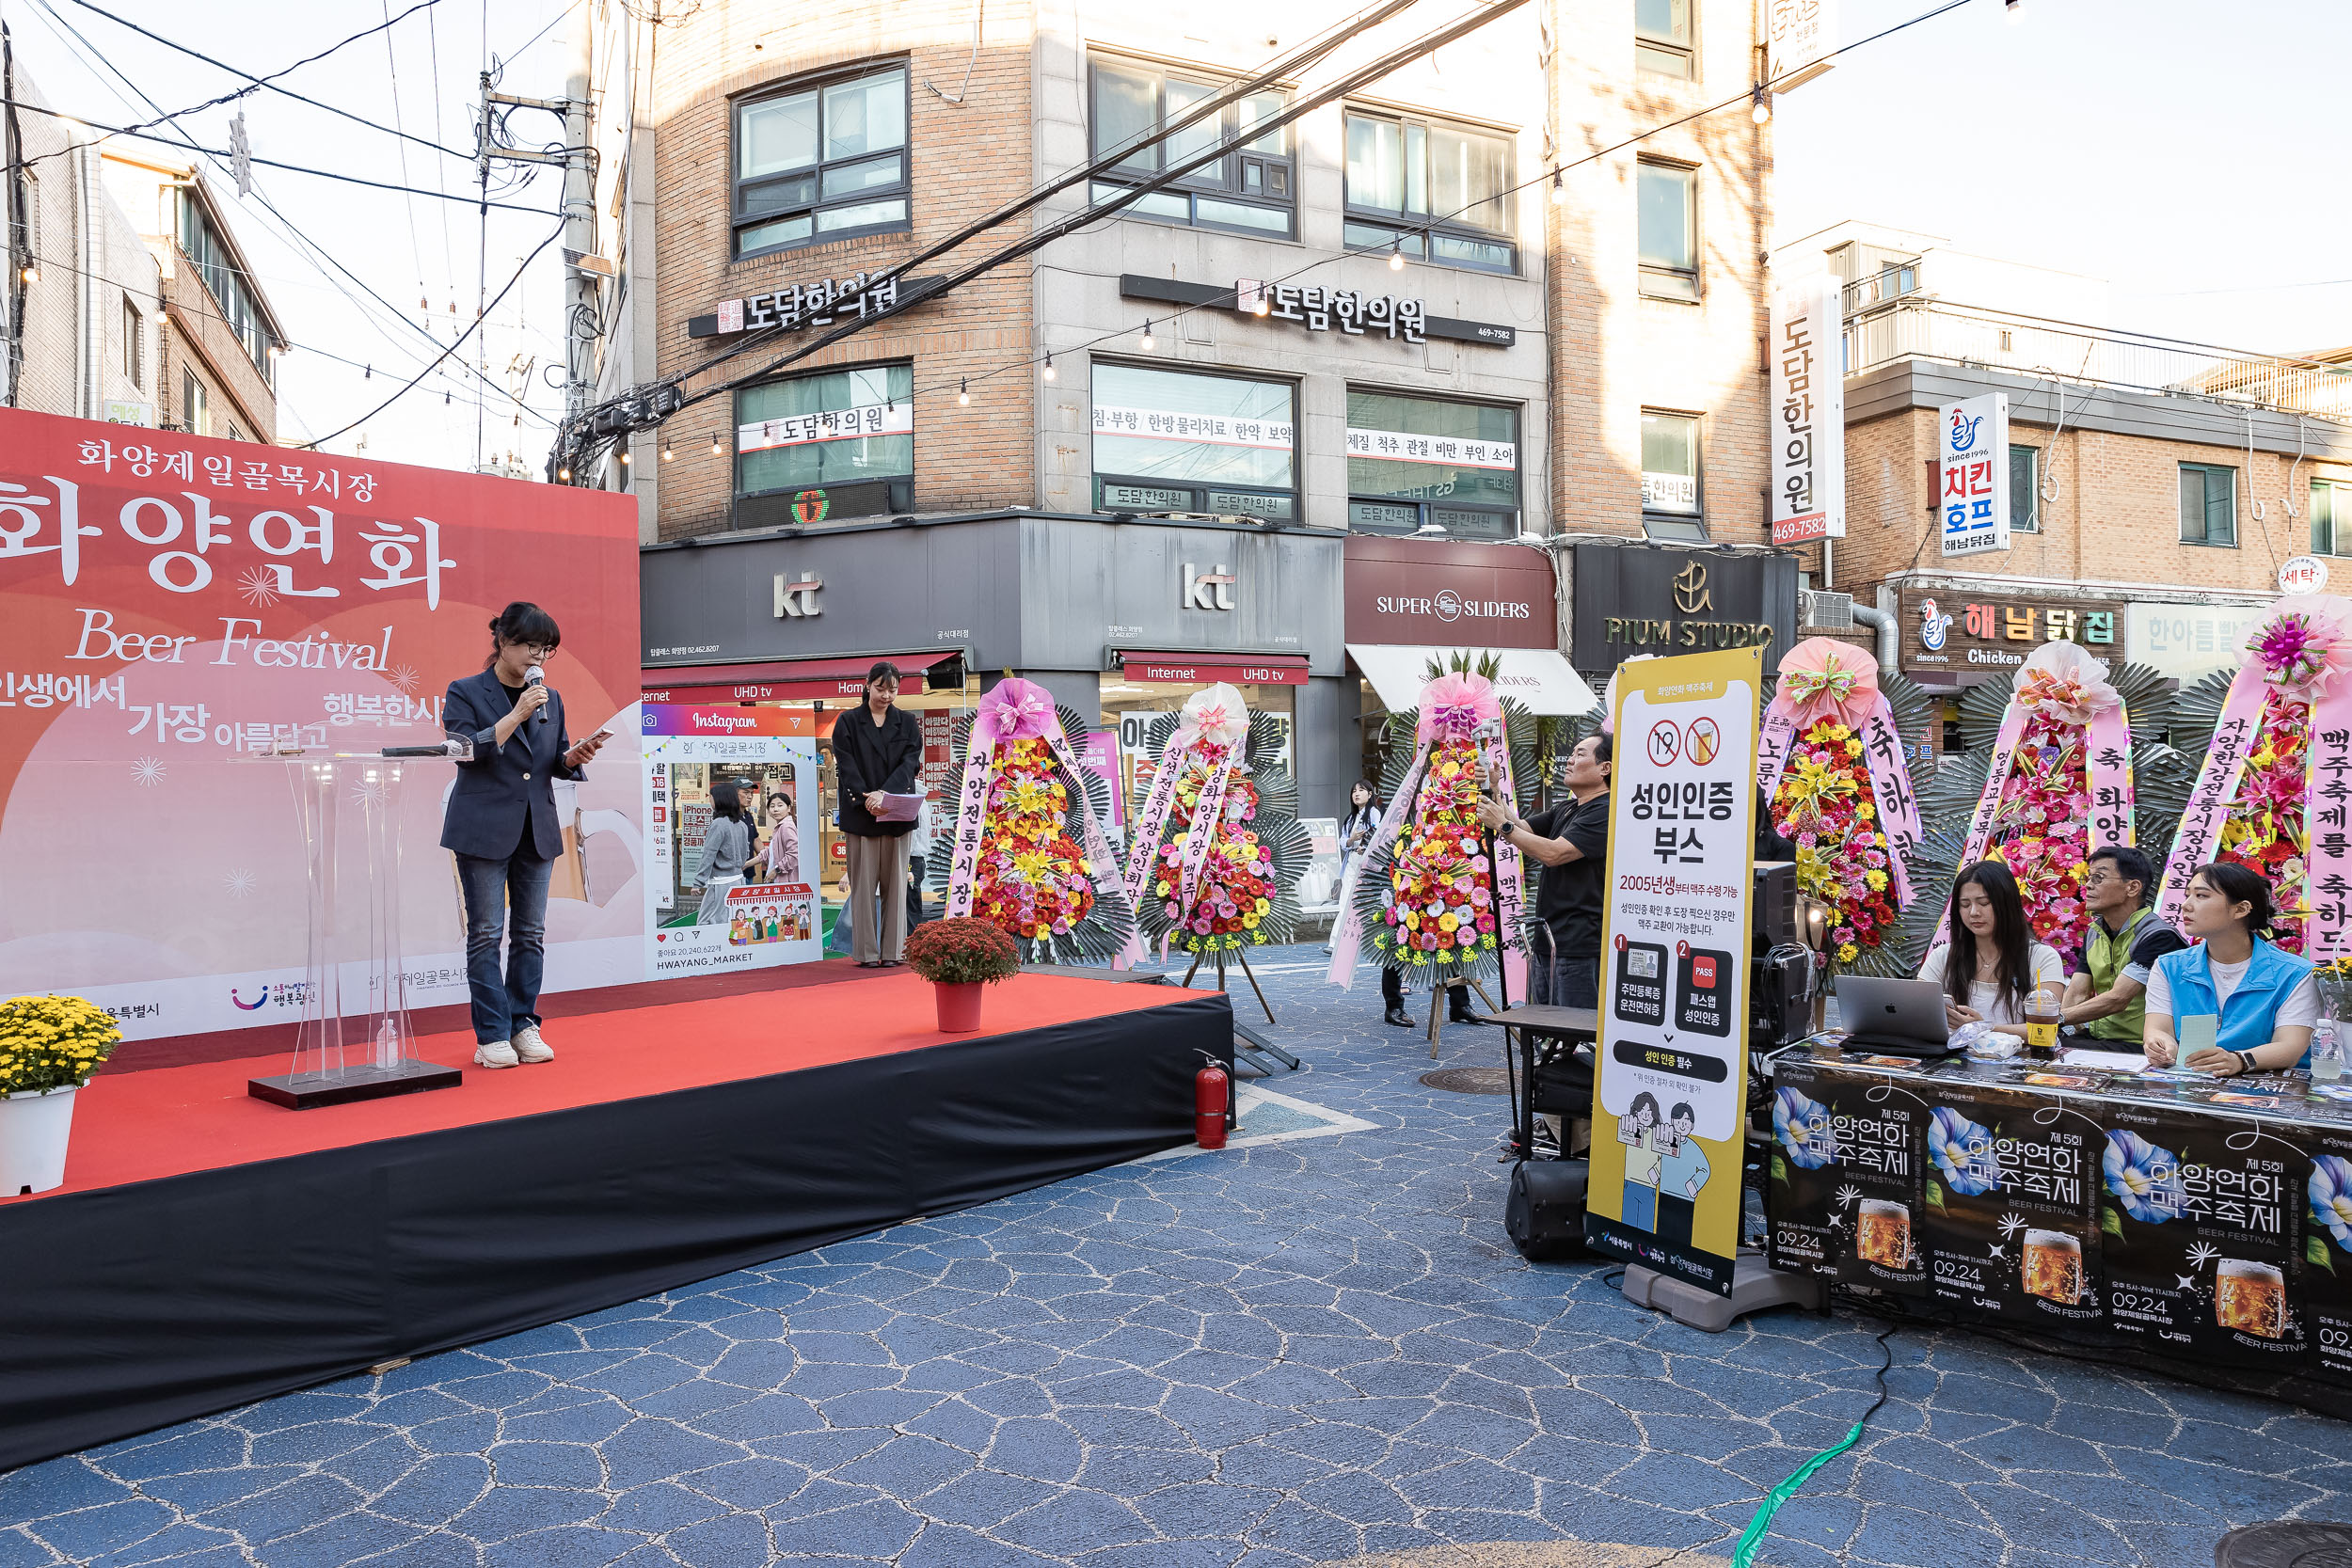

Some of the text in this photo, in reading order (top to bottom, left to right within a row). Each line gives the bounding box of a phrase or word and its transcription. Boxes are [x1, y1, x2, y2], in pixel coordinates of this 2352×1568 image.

[747, 266, 897, 329] 도담한의원
[1269, 284, 1426, 343] 도담한의원
[1478, 326, 1511, 341] 469-7582
[1092, 408, 1293, 443] 침·부항 한방 물리치료 한약 보약
[1782, 316, 1814, 515] 도담한의원
[1347, 434, 1514, 463] 체질 척추 관절 비만 부인 소아
[77, 437, 378, 503] 화양제일골목시장
[1945, 459, 1993, 499] 치킨
[1118, 488, 1182, 507] 도담한의원
[1216, 495, 1278, 514] 도담한의원
[1360, 506, 1417, 524] 도담한의원
[1437, 511, 1491, 529] 도담한의원
[1946, 499, 1994, 534] 호프
[1774, 516, 1826, 541] 469-7582
[0, 474, 457, 611] 화양연화
[1945, 533, 1995, 551] 해남닭집
[1183, 562, 1235, 610] kt
[2283, 567, 2316, 585] 세탁
[773, 570, 825, 618] kt
[1376, 595, 1531, 620] SUPER SLIDERS
[1963, 602, 2114, 643] 해남닭집
[66, 608, 391, 672] Beer Festival
[1605, 617, 1775, 649] PIUM STUDIO
[1967, 648, 2022, 665] Chicken
[1147, 666, 1284, 681] Internet UHD tv
[1492, 676, 1541, 687] LIDERS
[734, 686, 758, 698] UHD
[759, 687, 772, 698] tv
[1658, 681, 1713, 696] 화양연화 맥주축제
[127, 703, 212, 743] 가장
[692, 712, 758, 735] Instagram
[2094, 747, 2125, 771] 축
[683, 804, 713, 815] iPhone
[1630, 782, 1734, 821] 성인인증
[1653, 827, 1704, 864] 부스
[1690, 883, 1706, 896] 맥주
[1706, 885, 1723, 898] 수령
[1723, 886, 1739, 899] 가능
[1620, 902, 1736, 923] 성인인증 확인 후 도장 찍으신 경우만
[1638, 919, 1714, 936] 맥주 교환이 가능합니다.
[1679, 942, 1687, 957] 2
[657, 953, 754, 971] HWAYANG_MARKET
[1694, 966, 1713, 977] PASS
[1621, 983, 1661, 1001] 주민등록증
[1690, 992, 1717, 1008] 패스앱
[1620, 998, 1661, 1017] 운전면허증
[1684, 1009, 1721, 1027] 성인인증
[1645, 1051, 1692, 1069] 성인 인증 필수
[1882, 1108, 1910, 1122] 제 5회
[1808, 1112, 1910, 1148] 화양연화
[2050, 1132, 2082, 1147] 제 5회
[1808, 1138, 1909, 1176] 맥주축제
[1968, 1134, 2082, 1175] 화양연화
[2246, 1158, 2283, 1174] 제 5회
[1845, 1171, 1908, 1188] BEER FESTIVAL
[1968, 1164, 2081, 1205] 맥주축제
[2150, 1159, 2283, 1203] 화양연화
[2009, 1198, 2079, 1217] BEER FESTIVAL
[2150, 1191, 2280, 1234] 맥주축제
[1776, 1230, 1820, 1250] 09.24
[2198, 1227, 2280, 1247] BEER FESTIVAL
[1869, 1264, 1891, 1280] BEER
[1933, 1259, 1981, 1281] 09.24
[2037, 1299, 2061, 1317] BEER
[2111, 1291, 2169, 1315] 09.24
[2233, 1332, 2262, 1350] BEER
